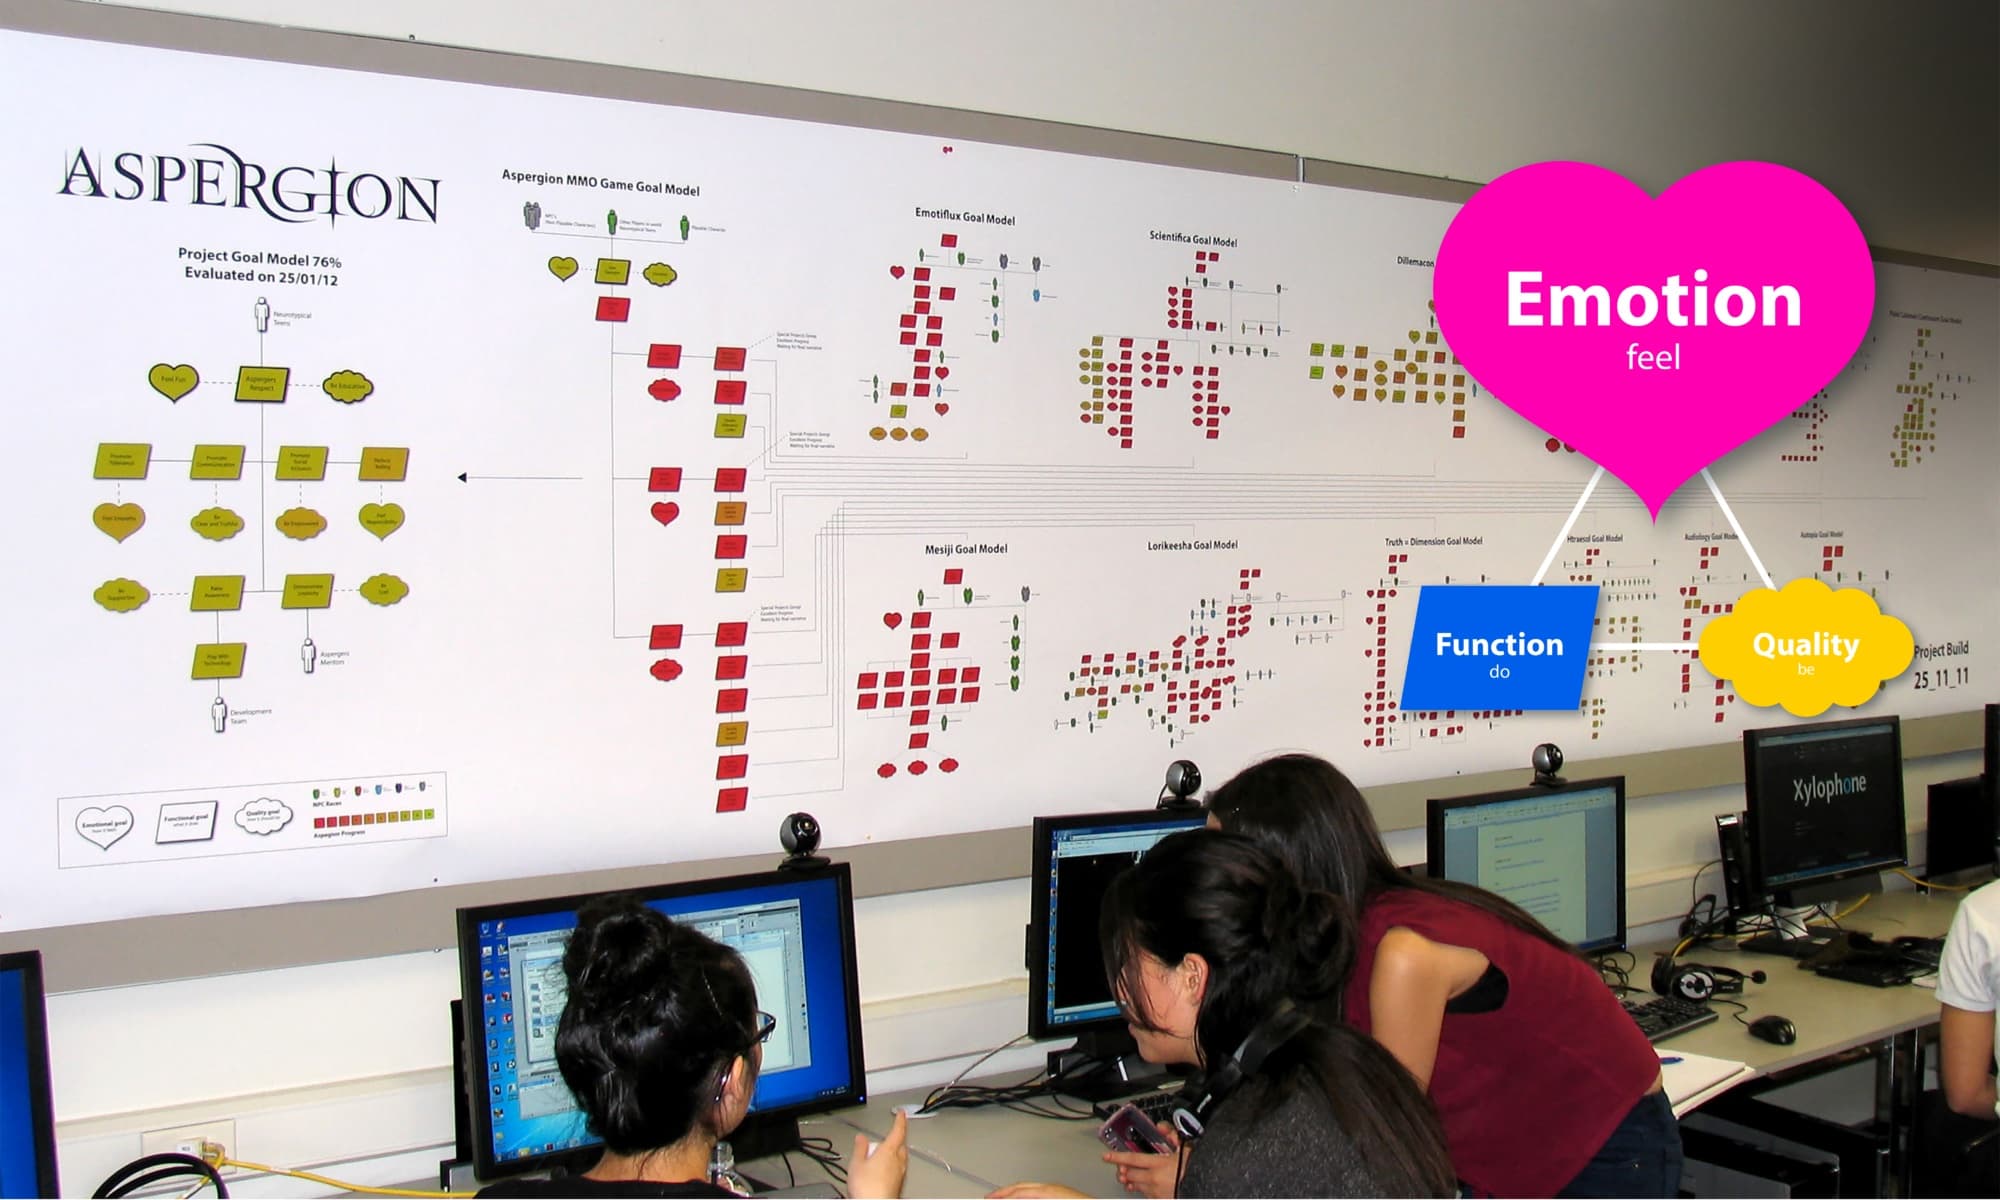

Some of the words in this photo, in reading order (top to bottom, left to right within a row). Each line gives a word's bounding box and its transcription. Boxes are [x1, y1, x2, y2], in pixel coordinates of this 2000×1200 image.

[56, 143, 443, 230] ASPERGION
[502, 168, 564, 186] Aspergion
[566, 175, 598, 188] MMO
[600, 178, 634, 191] Game
[636, 181, 663, 194] Goal
[665, 184, 701, 197] Model
[915, 207, 961, 220] Emotiflux
[963, 212, 985, 223] Goal
[986, 214, 1015, 226] Model
[1150, 230, 1191, 244] Scientifica
[1192, 234, 1212, 245] Goal
[1213, 236, 1238, 248] Model
[178, 247, 228, 263] Project
[231, 250, 263, 264] Goal
[267, 253, 309, 267] Model
[313, 256, 342, 269] 76%
[185, 266, 254, 282] Evaluated
[258, 272, 276, 283] on
[279, 272, 339, 287] 25/01/12
[1147, 540, 1192, 551] Lorikeesha
[1193, 540, 1212, 550] Goal
[1213, 539, 1238, 550] Model
[1385, 537, 1404, 546] Truth
[1410, 537, 1446, 546] Dimension
[1446, 537, 1462, 545] Goal
[1463, 536, 1483, 545] Model
[1591, 533, 1604, 543] Goal
[1606, 533, 1623, 543] Model
[1711, 532, 1722, 541] Goal
[1724, 532, 1739, 541] Mode
[925, 544, 954, 557] Mesiji
[955, 544, 977, 554] Goal
[979, 543, 1008, 554] Model
[1914, 643, 1945, 661] Project
[1946, 640, 1969, 656] Build
[1914, 666, 1968, 691] 25_11_11
[1793, 772, 1867, 807] Xylophone
